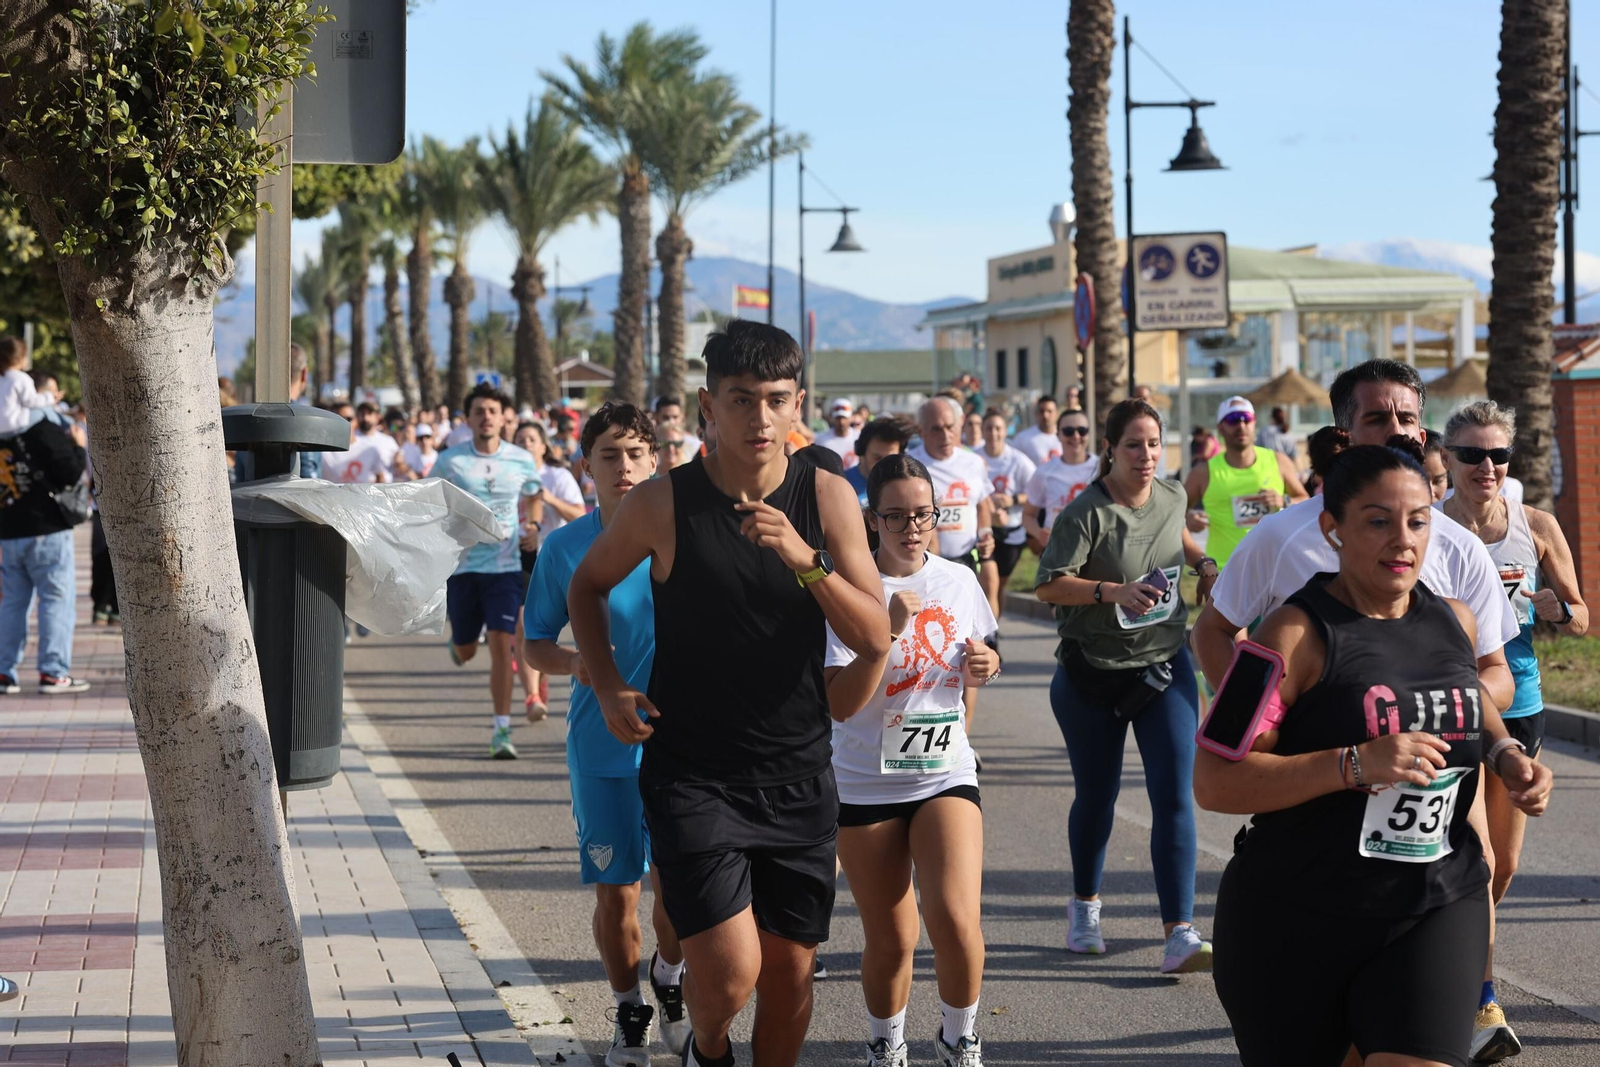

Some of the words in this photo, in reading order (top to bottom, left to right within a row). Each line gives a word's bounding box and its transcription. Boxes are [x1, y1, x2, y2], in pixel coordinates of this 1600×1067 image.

[1147, 302, 1164, 310] EN
[1168, 300, 1215, 309] CARRIL
[899, 725, 951, 753] 714
[885, 761, 900, 769] 024
[1387, 792, 1451, 835] 531
[1365, 840, 1388, 852] 024
